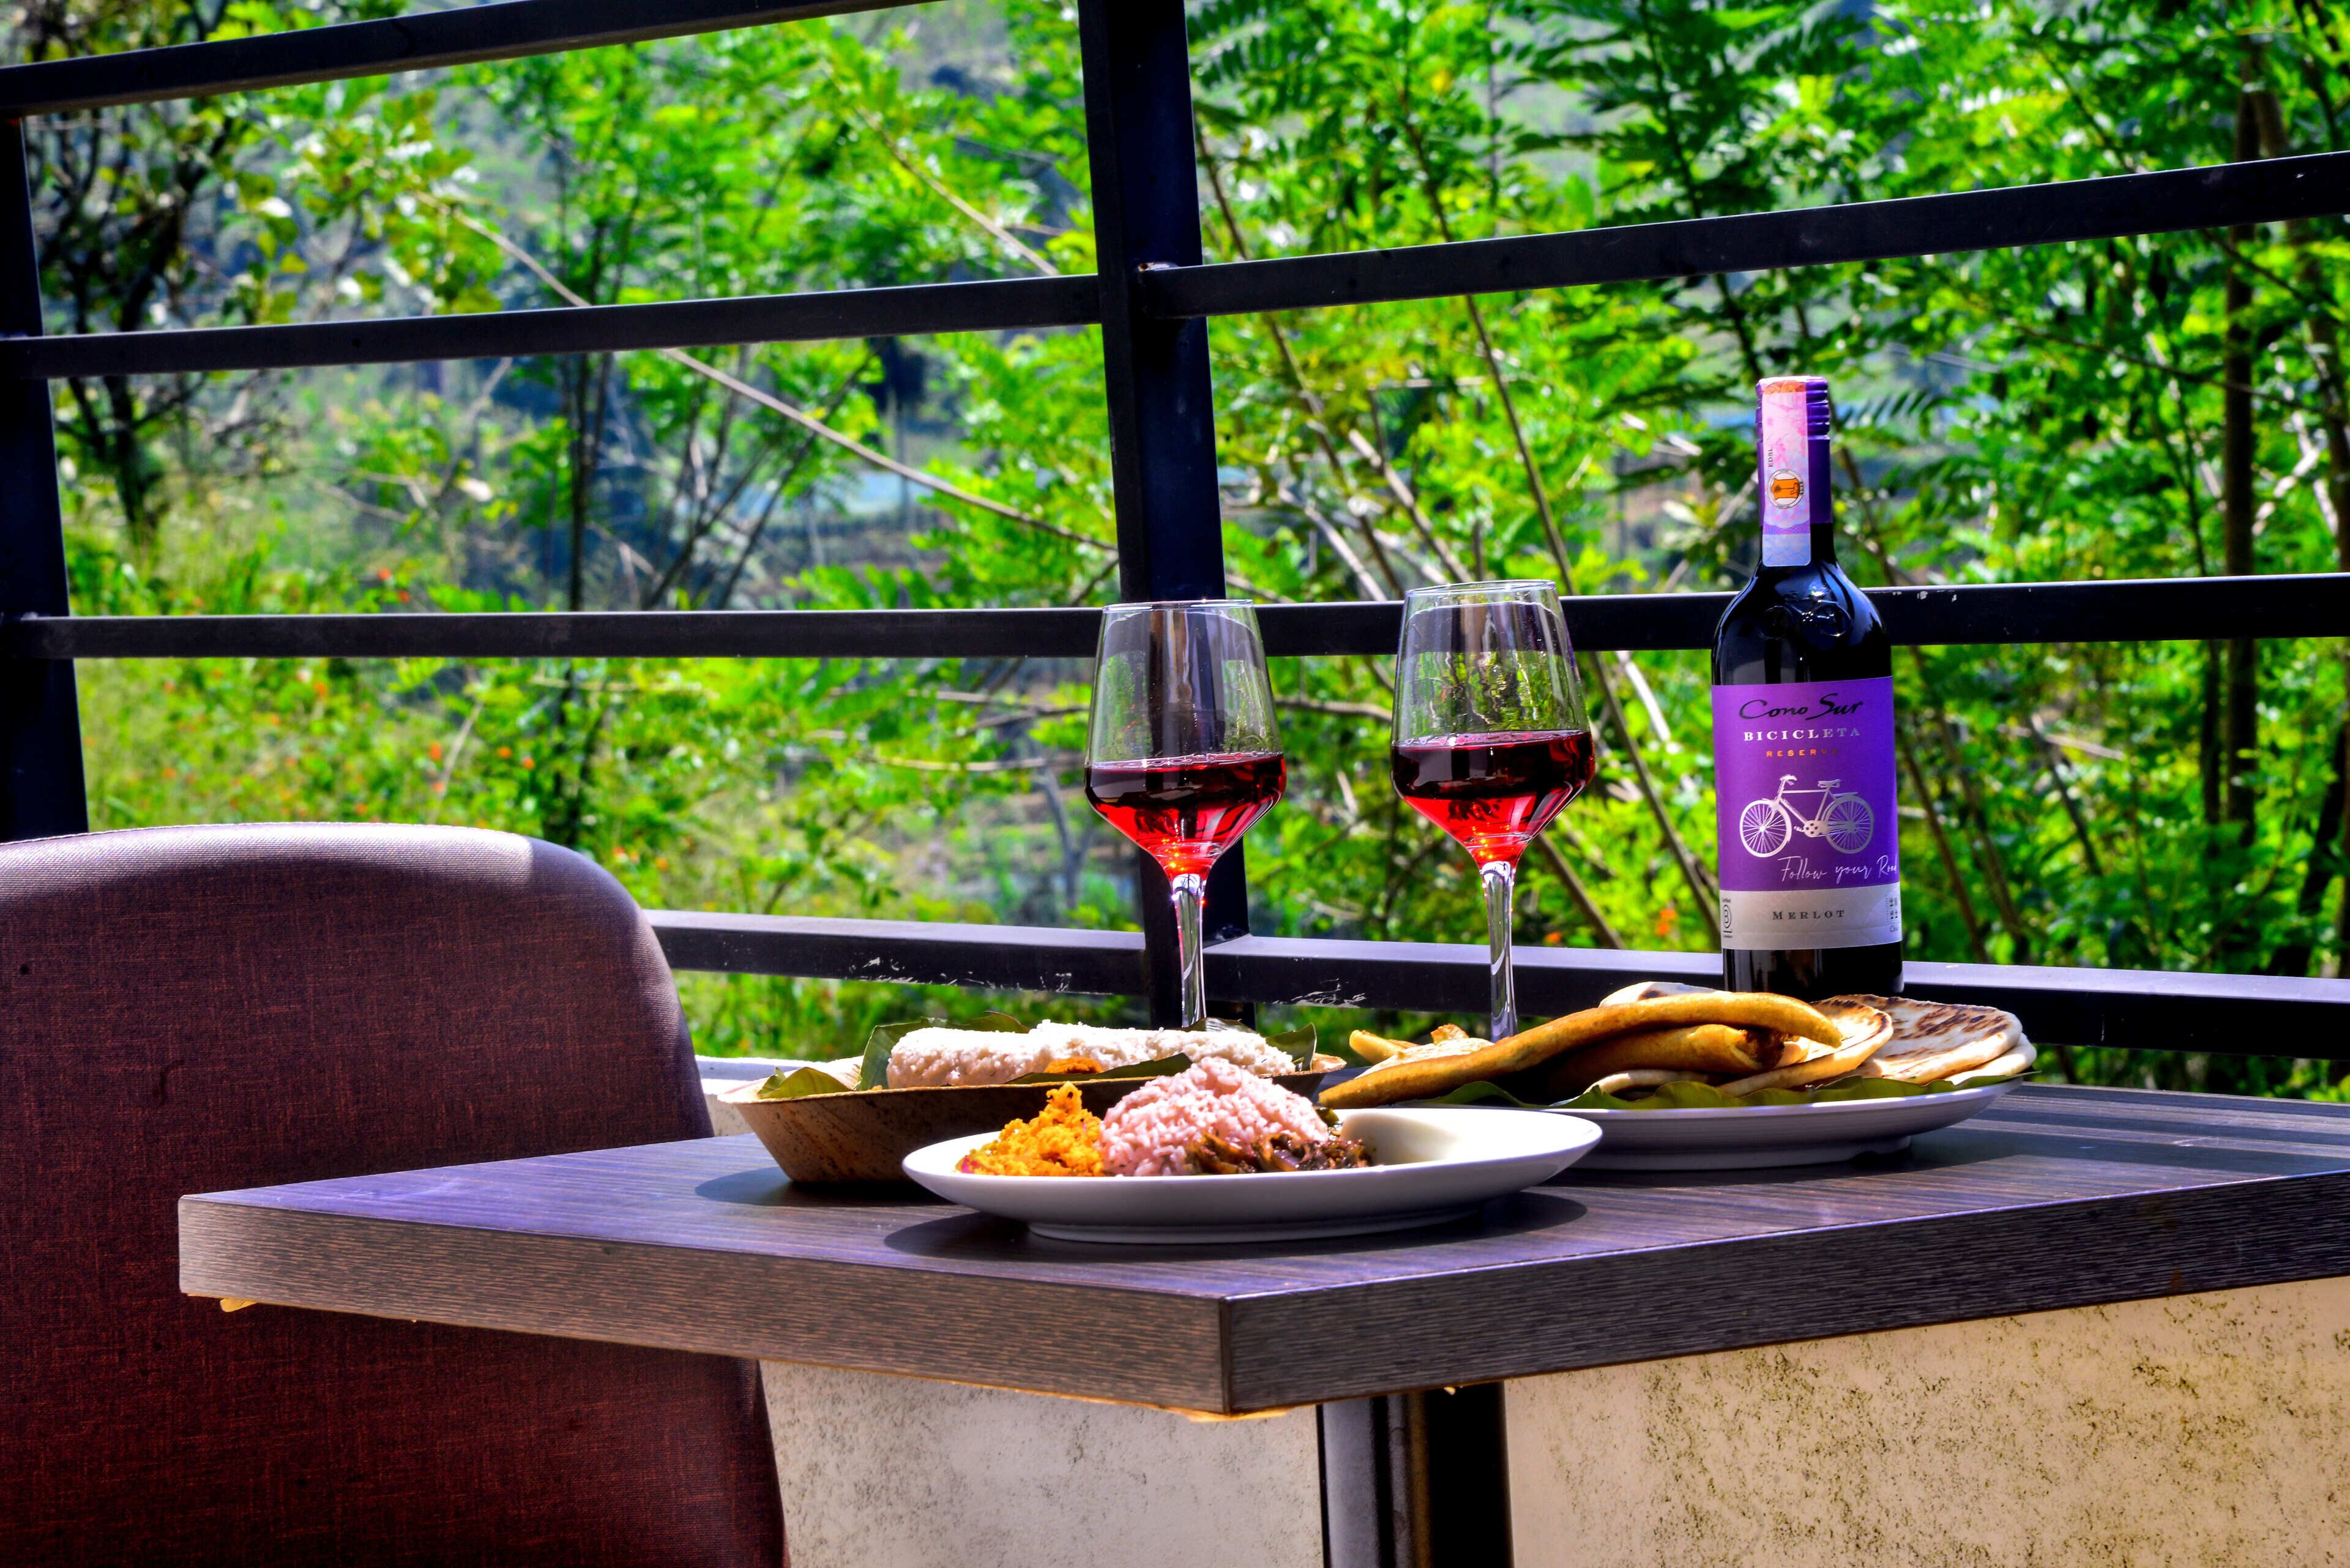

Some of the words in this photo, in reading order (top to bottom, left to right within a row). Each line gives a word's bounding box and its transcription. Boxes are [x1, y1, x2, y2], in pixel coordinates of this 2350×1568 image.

[1739, 699, 1808, 720] Cono
[1805, 693, 1864, 720] Sur
[1743, 726, 1860, 741] BICICLETA
[1777, 855, 1827, 882] Follow
[1835, 865, 1873, 884] your
[1772, 909, 1845, 920] MERLOT
